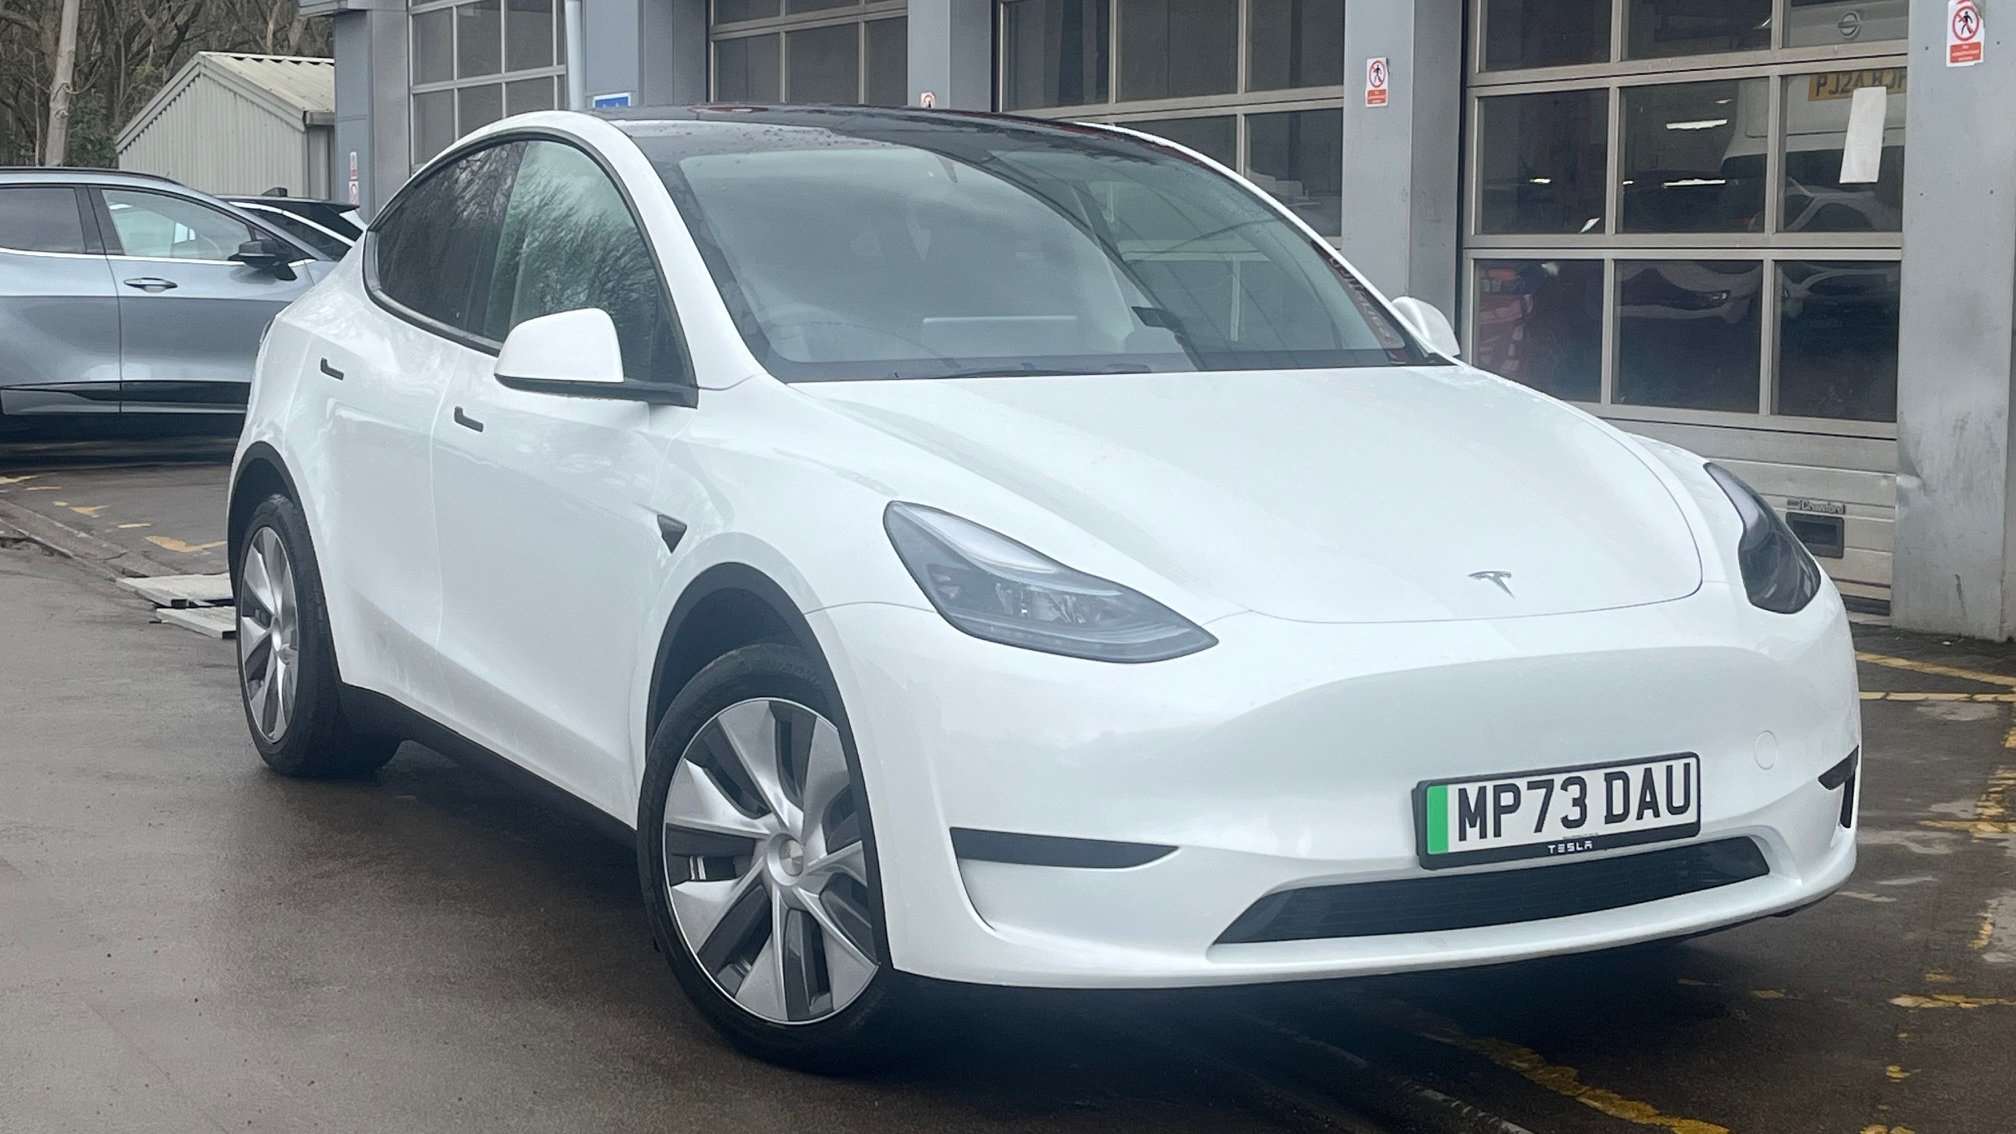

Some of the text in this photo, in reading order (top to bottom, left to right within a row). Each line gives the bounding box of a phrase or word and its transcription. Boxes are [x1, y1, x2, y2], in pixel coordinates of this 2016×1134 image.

[1458, 762, 1691, 842] MP73 DAU
[1548, 840, 1593, 854] TESLA
